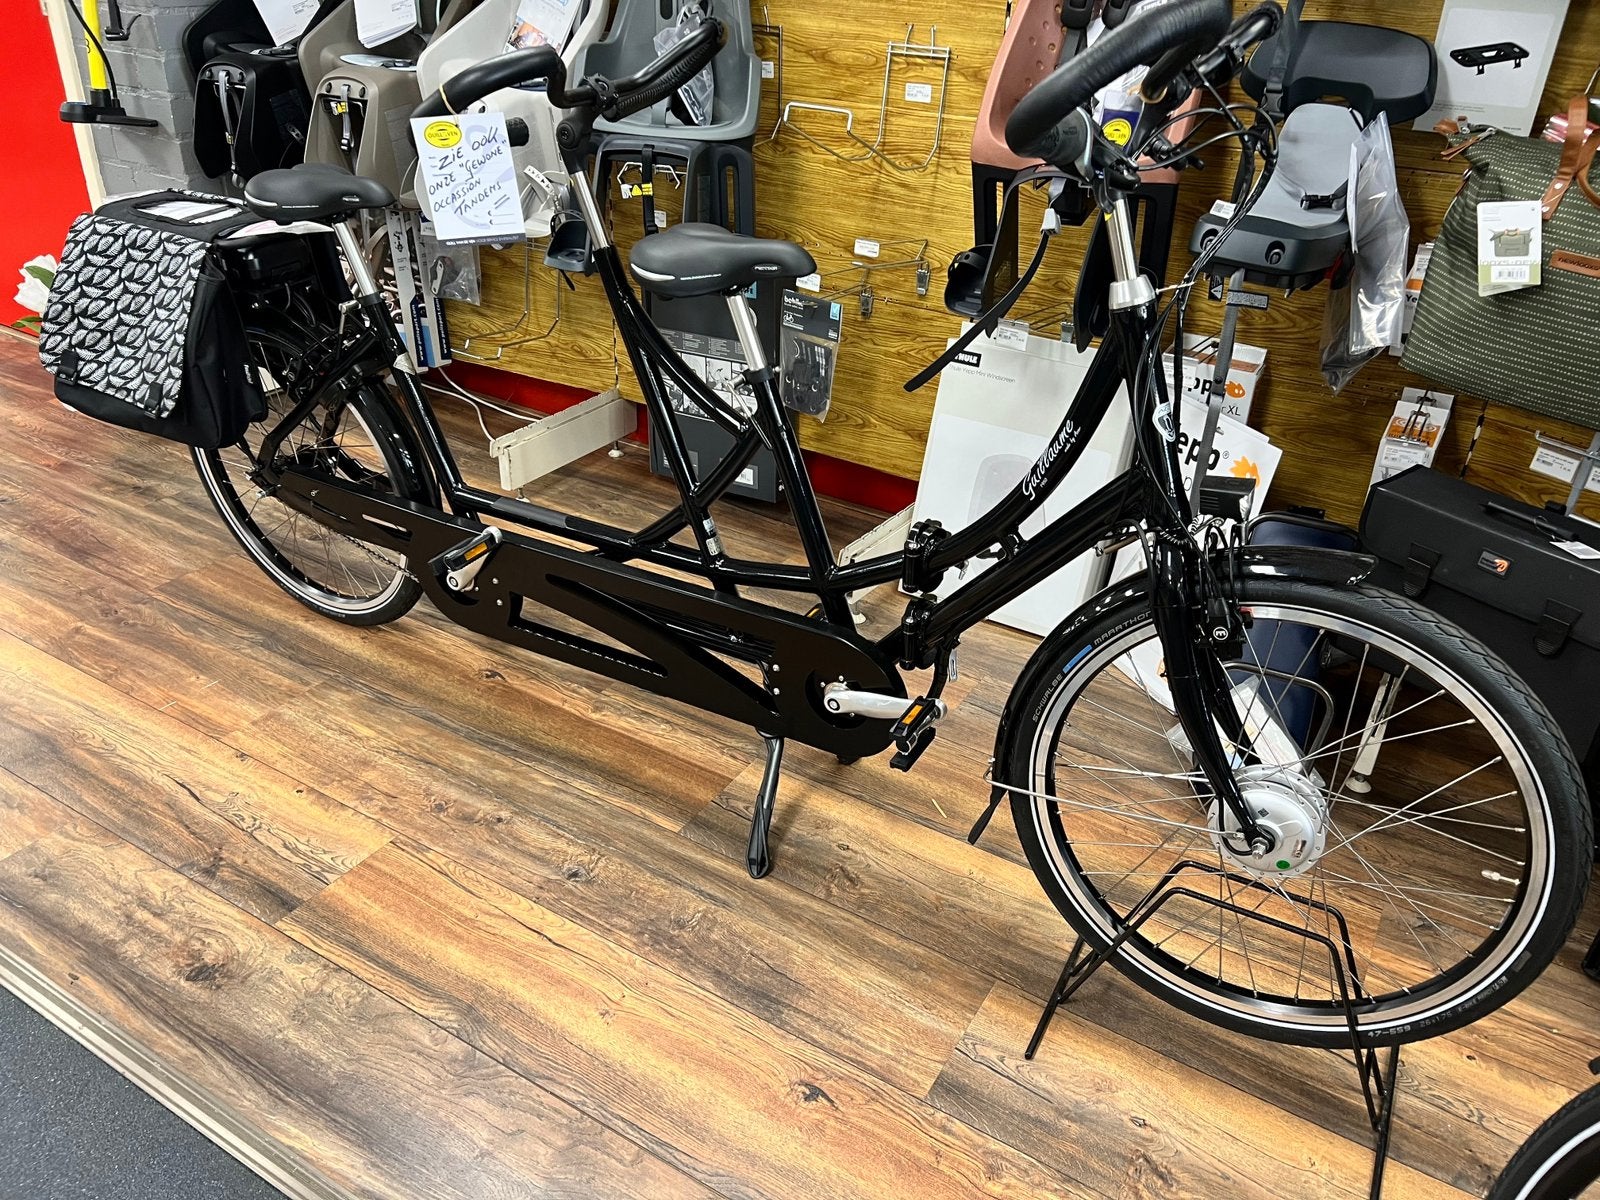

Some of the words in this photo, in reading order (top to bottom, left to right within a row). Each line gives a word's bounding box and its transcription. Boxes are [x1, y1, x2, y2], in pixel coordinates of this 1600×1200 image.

[454, 181, 501, 215] TANDEMS
[1227, 404, 1241, 417] XL
[1022, 419, 1074, 501] Guillaume
[1032, 673, 1063, 722] SCHWALBE
[1367, 1025, 1411, 1038] 47-559
